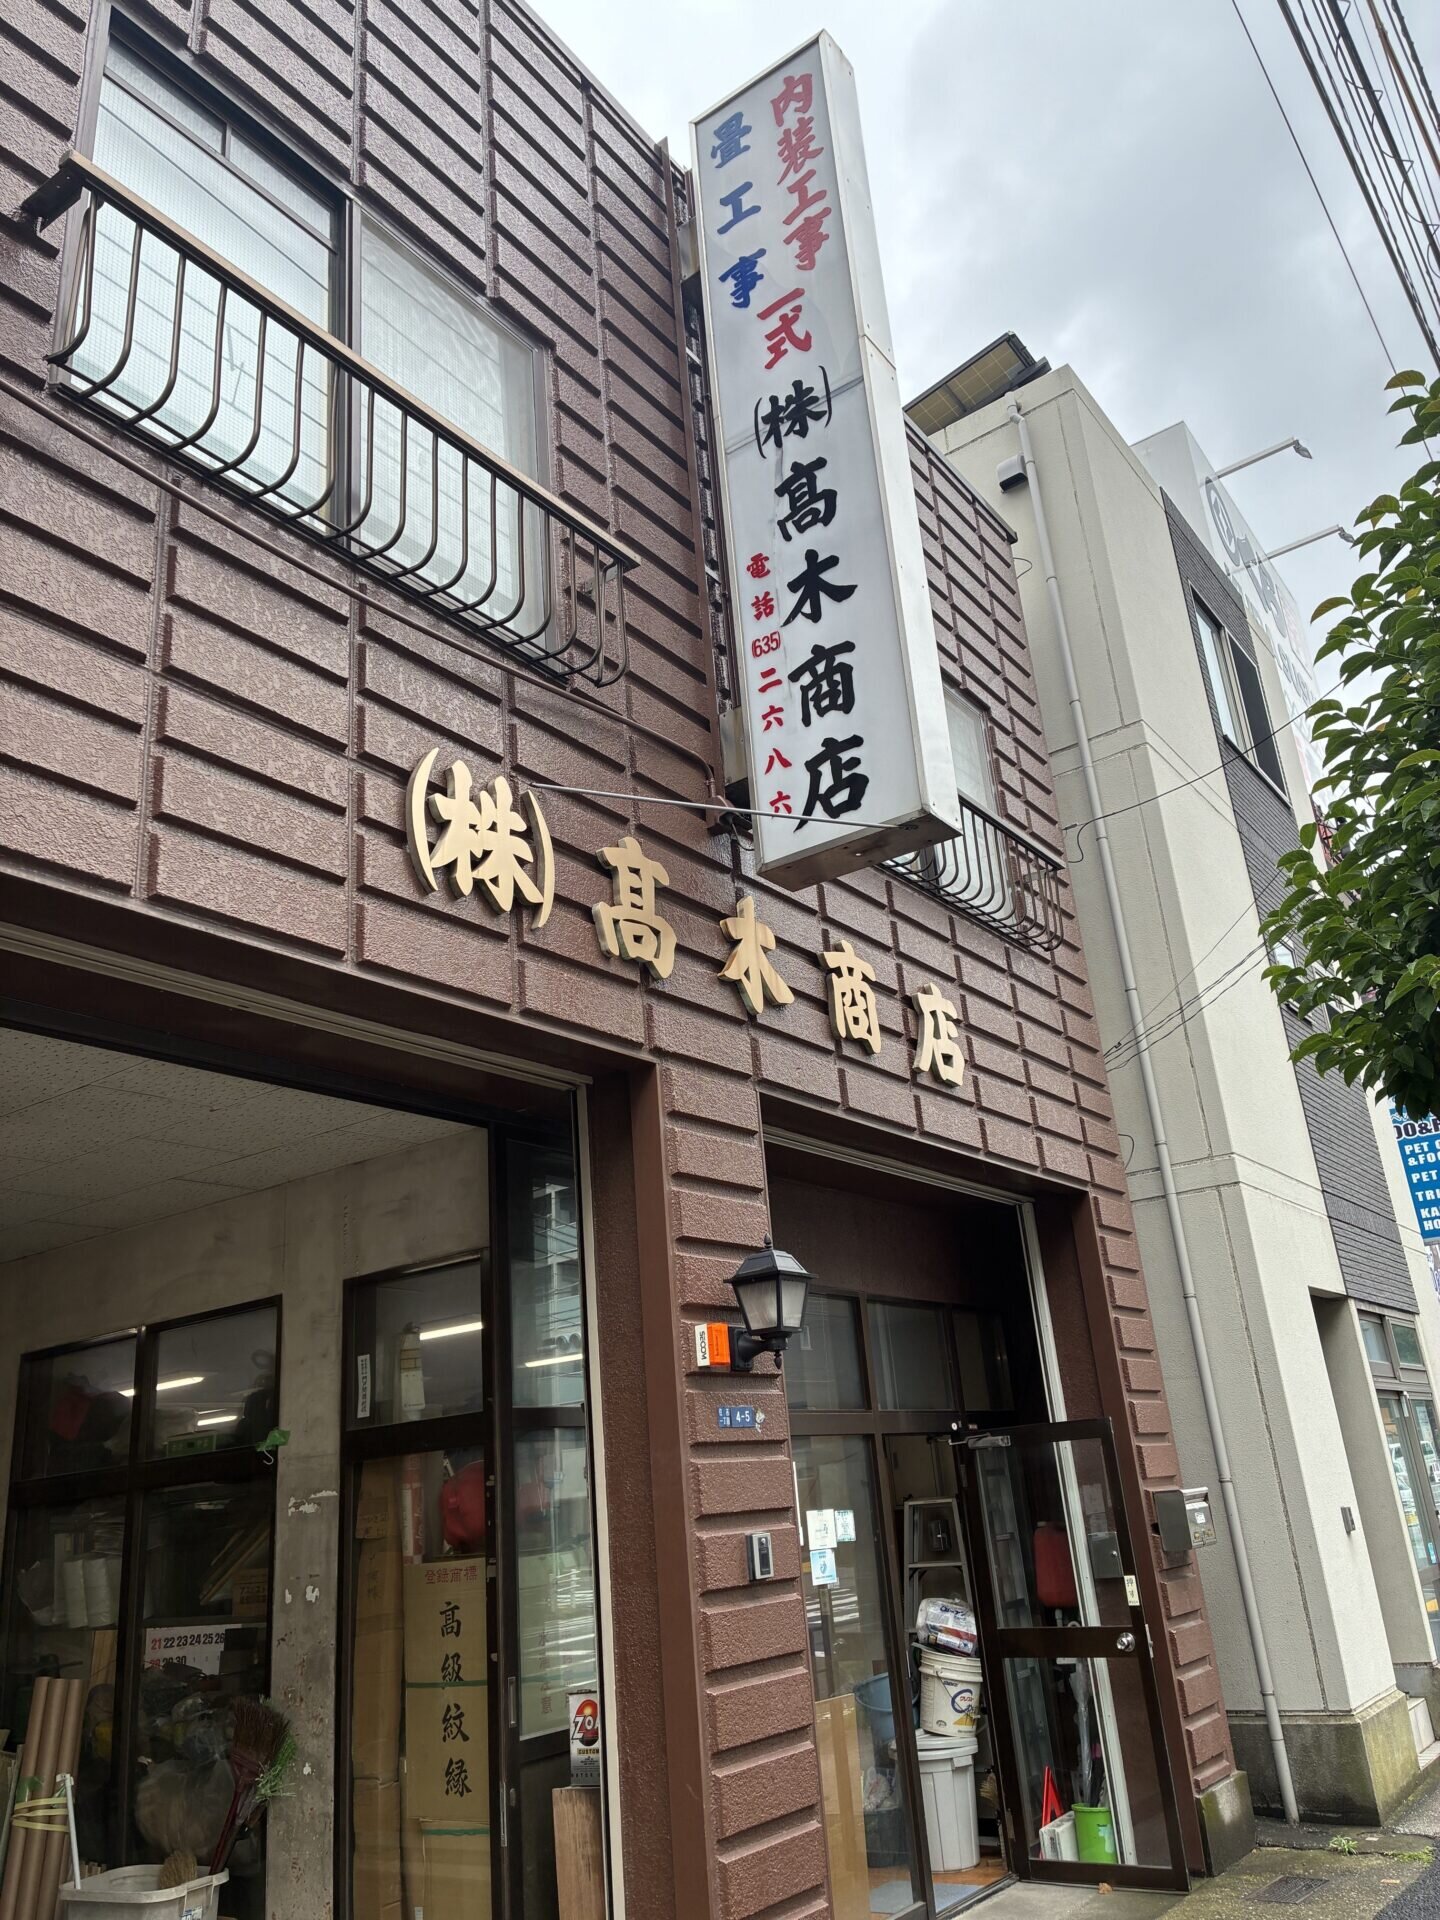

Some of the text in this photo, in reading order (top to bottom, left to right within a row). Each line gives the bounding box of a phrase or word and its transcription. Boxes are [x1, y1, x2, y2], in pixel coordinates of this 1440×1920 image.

[710, 111, 767, 309] 畳工事
[1404, 1142, 1429, 1155] PET
[1411, 1169, 1438, 1183] PET
[699, 1330, 708, 1360] SECOM
[735, 1409, 751, 1423] 4-5
[151, 1639, 162, 1650] 21
[163, 1637, 175, 1649] 22
[176, 1635, 188, 1647] 23
[189, 1634, 201, 1646] 24
[202, 1633, 213, 1645] 25
